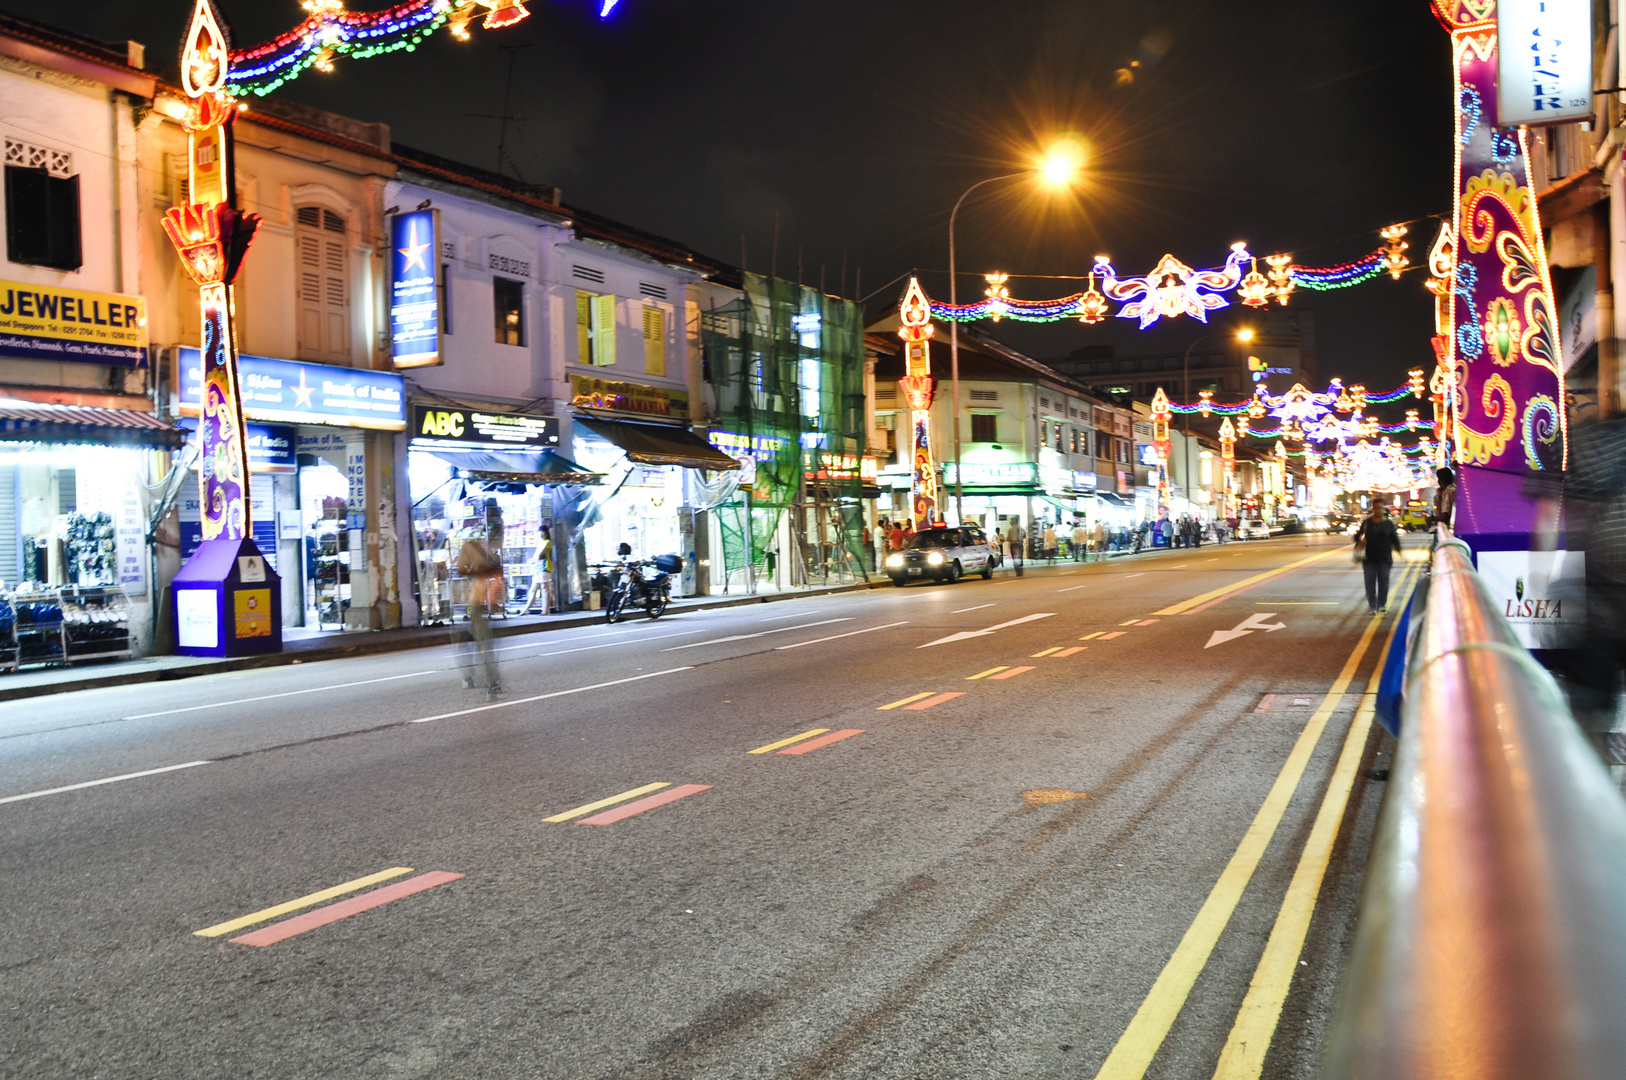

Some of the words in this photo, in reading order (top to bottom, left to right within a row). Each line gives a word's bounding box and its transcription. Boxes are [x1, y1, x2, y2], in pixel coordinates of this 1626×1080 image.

[0, 289, 138, 329] JEWELLER
[13, 320, 45, 331] Singapore
[422, 410, 465, 437] ABC
[262, 436, 288, 448] India
[298, 434, 319, 445] Bank
[321, 434, 331, 443] of
[332, 434, 344, 443] In
